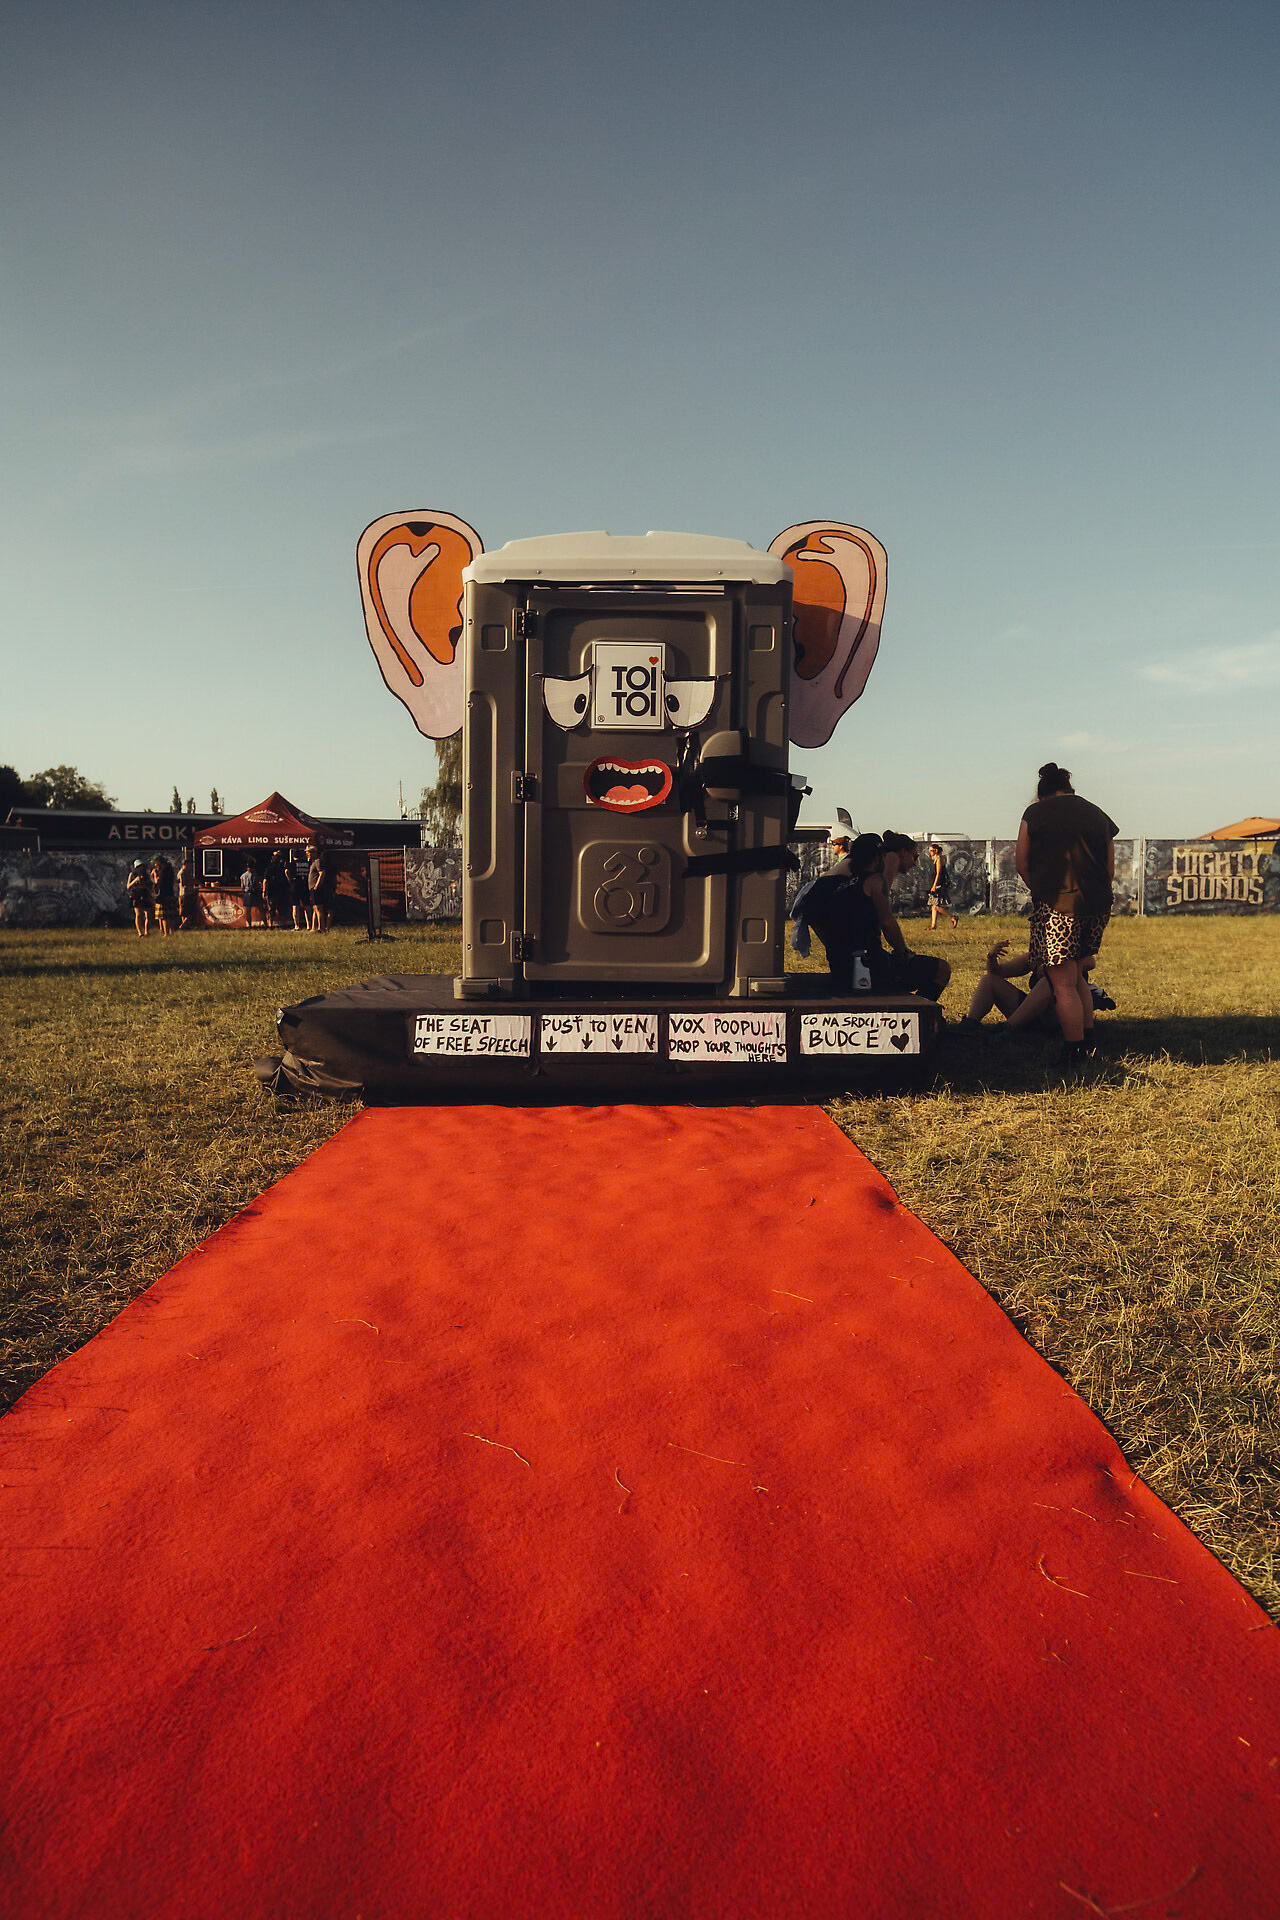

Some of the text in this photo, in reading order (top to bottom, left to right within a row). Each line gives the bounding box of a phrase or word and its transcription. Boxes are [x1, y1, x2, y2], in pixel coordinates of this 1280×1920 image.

[612, 666, 656, 691] TOI
[612, 692, 656, 716] TOI
[221, 835, 243, 844] KÁVA
[248, 836, 269, 844] LIMO
[274, 835, 310, 844] SUŠENKY
[1172, 847, 1264, 876] MIGHTY
[1166, 875, 1264, 906] SOUNDS
[416, 1017, 491, 1034] THE SEAT
[613, 1017, 648, 1034] VEN
[670, 1017, 706, 1034] VOX
[803, 1016, 818, 1025] CO
[822, 1017, 839, 1027] NA
[880, 1018, 897, 1030] TO
[414, 1036, 528, 1053] OF FREE SPEECH
[669, 1039, 786, 1056] DROP YOUR THOUGHTS
[748, 1053, 777, 1062] HERE
